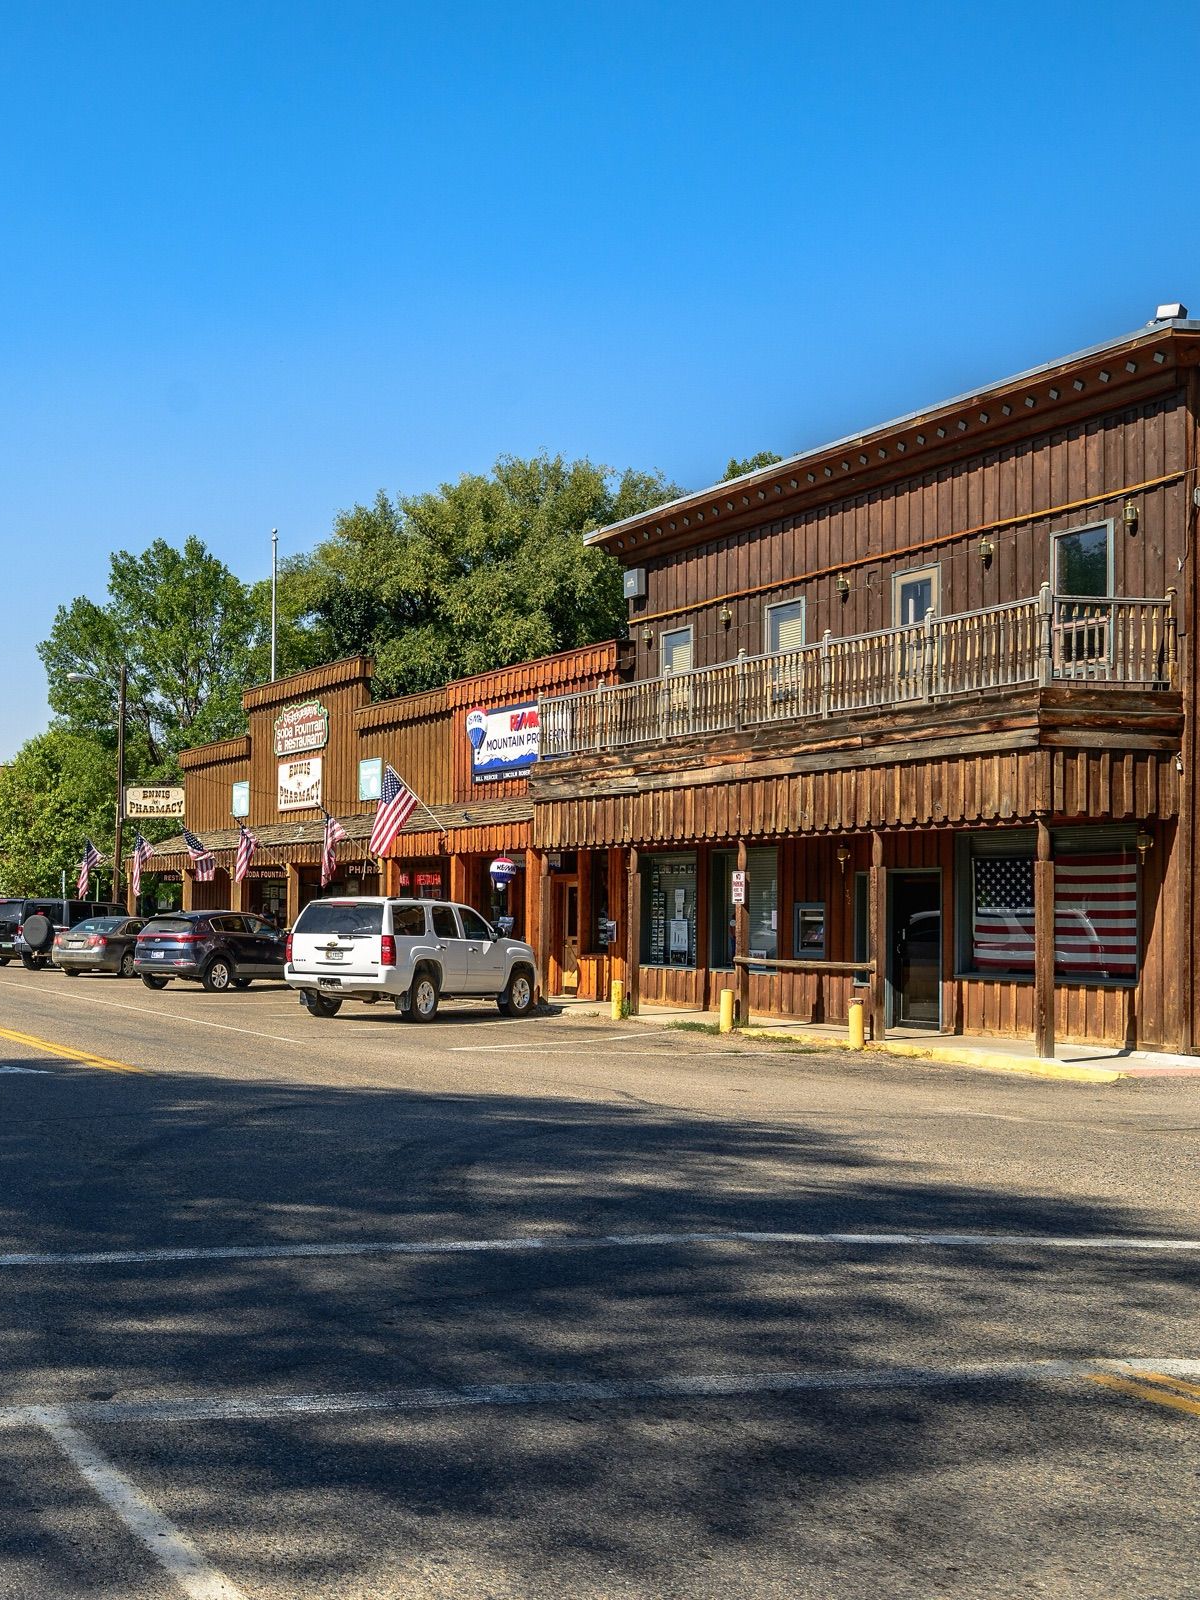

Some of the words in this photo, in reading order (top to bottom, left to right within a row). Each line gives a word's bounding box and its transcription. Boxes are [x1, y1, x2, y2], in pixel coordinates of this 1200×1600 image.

[486, 734, 525, 751] MOUNTAIN
[289, 761, 311, 779] ENNIS
[142, 790, 171, 800] ENNIS
[279, 779, 321, 805] PHARMACY
[129, 800, 183, 814] PHARMACY
